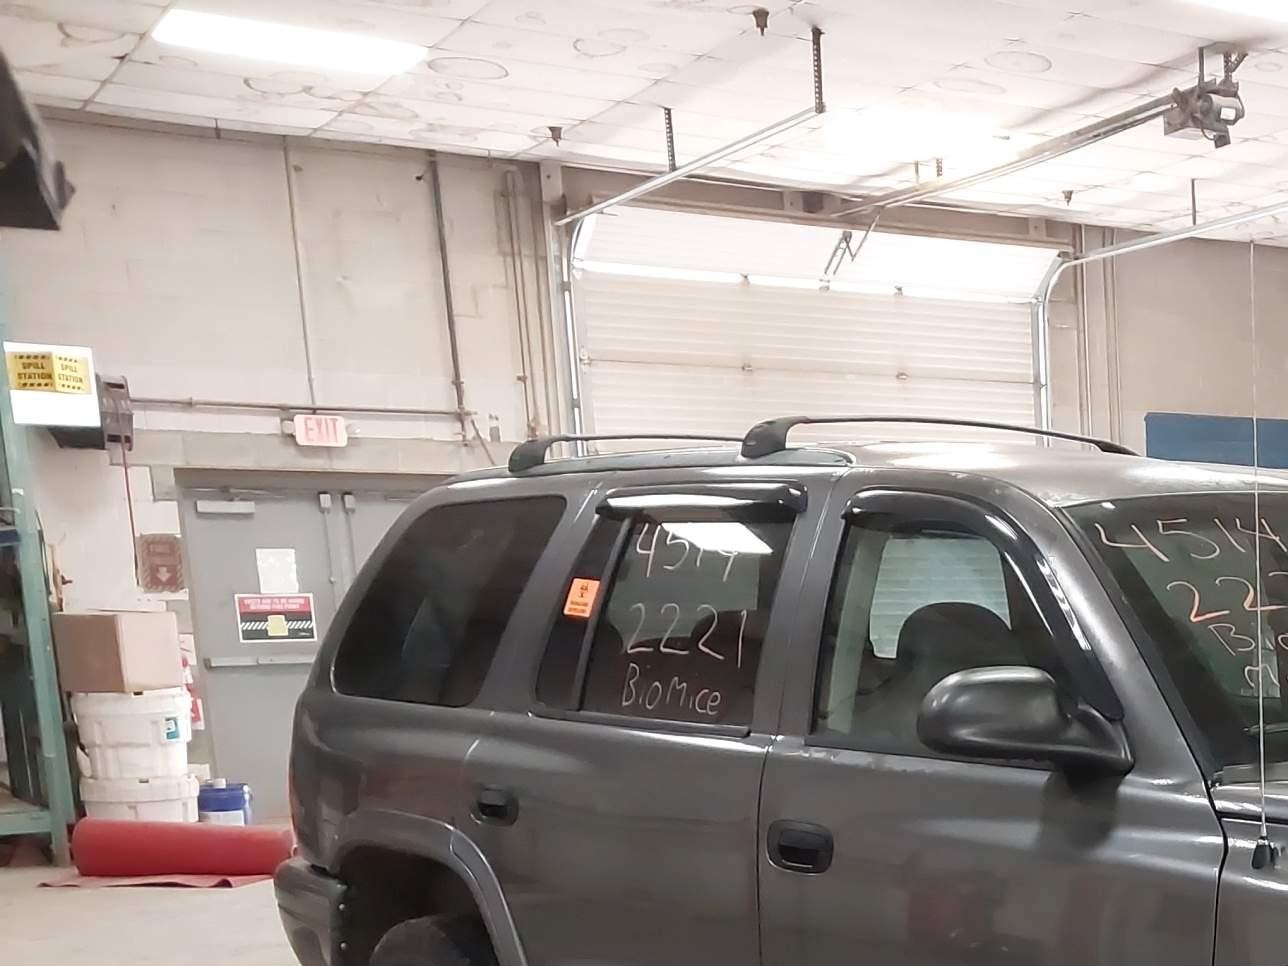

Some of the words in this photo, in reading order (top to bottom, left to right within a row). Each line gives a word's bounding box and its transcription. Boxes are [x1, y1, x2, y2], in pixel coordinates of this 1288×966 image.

[22, 362, 45, 370] SPILL
[60, 363, 78, 373] SPILL
[17, 372, 52, 380] STATION
[58, 373, 83, 384] STATION
[304, 416, 338, 442] EXIT
[1094, 518, 1288, 563] 4514
[627, 603, 748, 668] 2221
